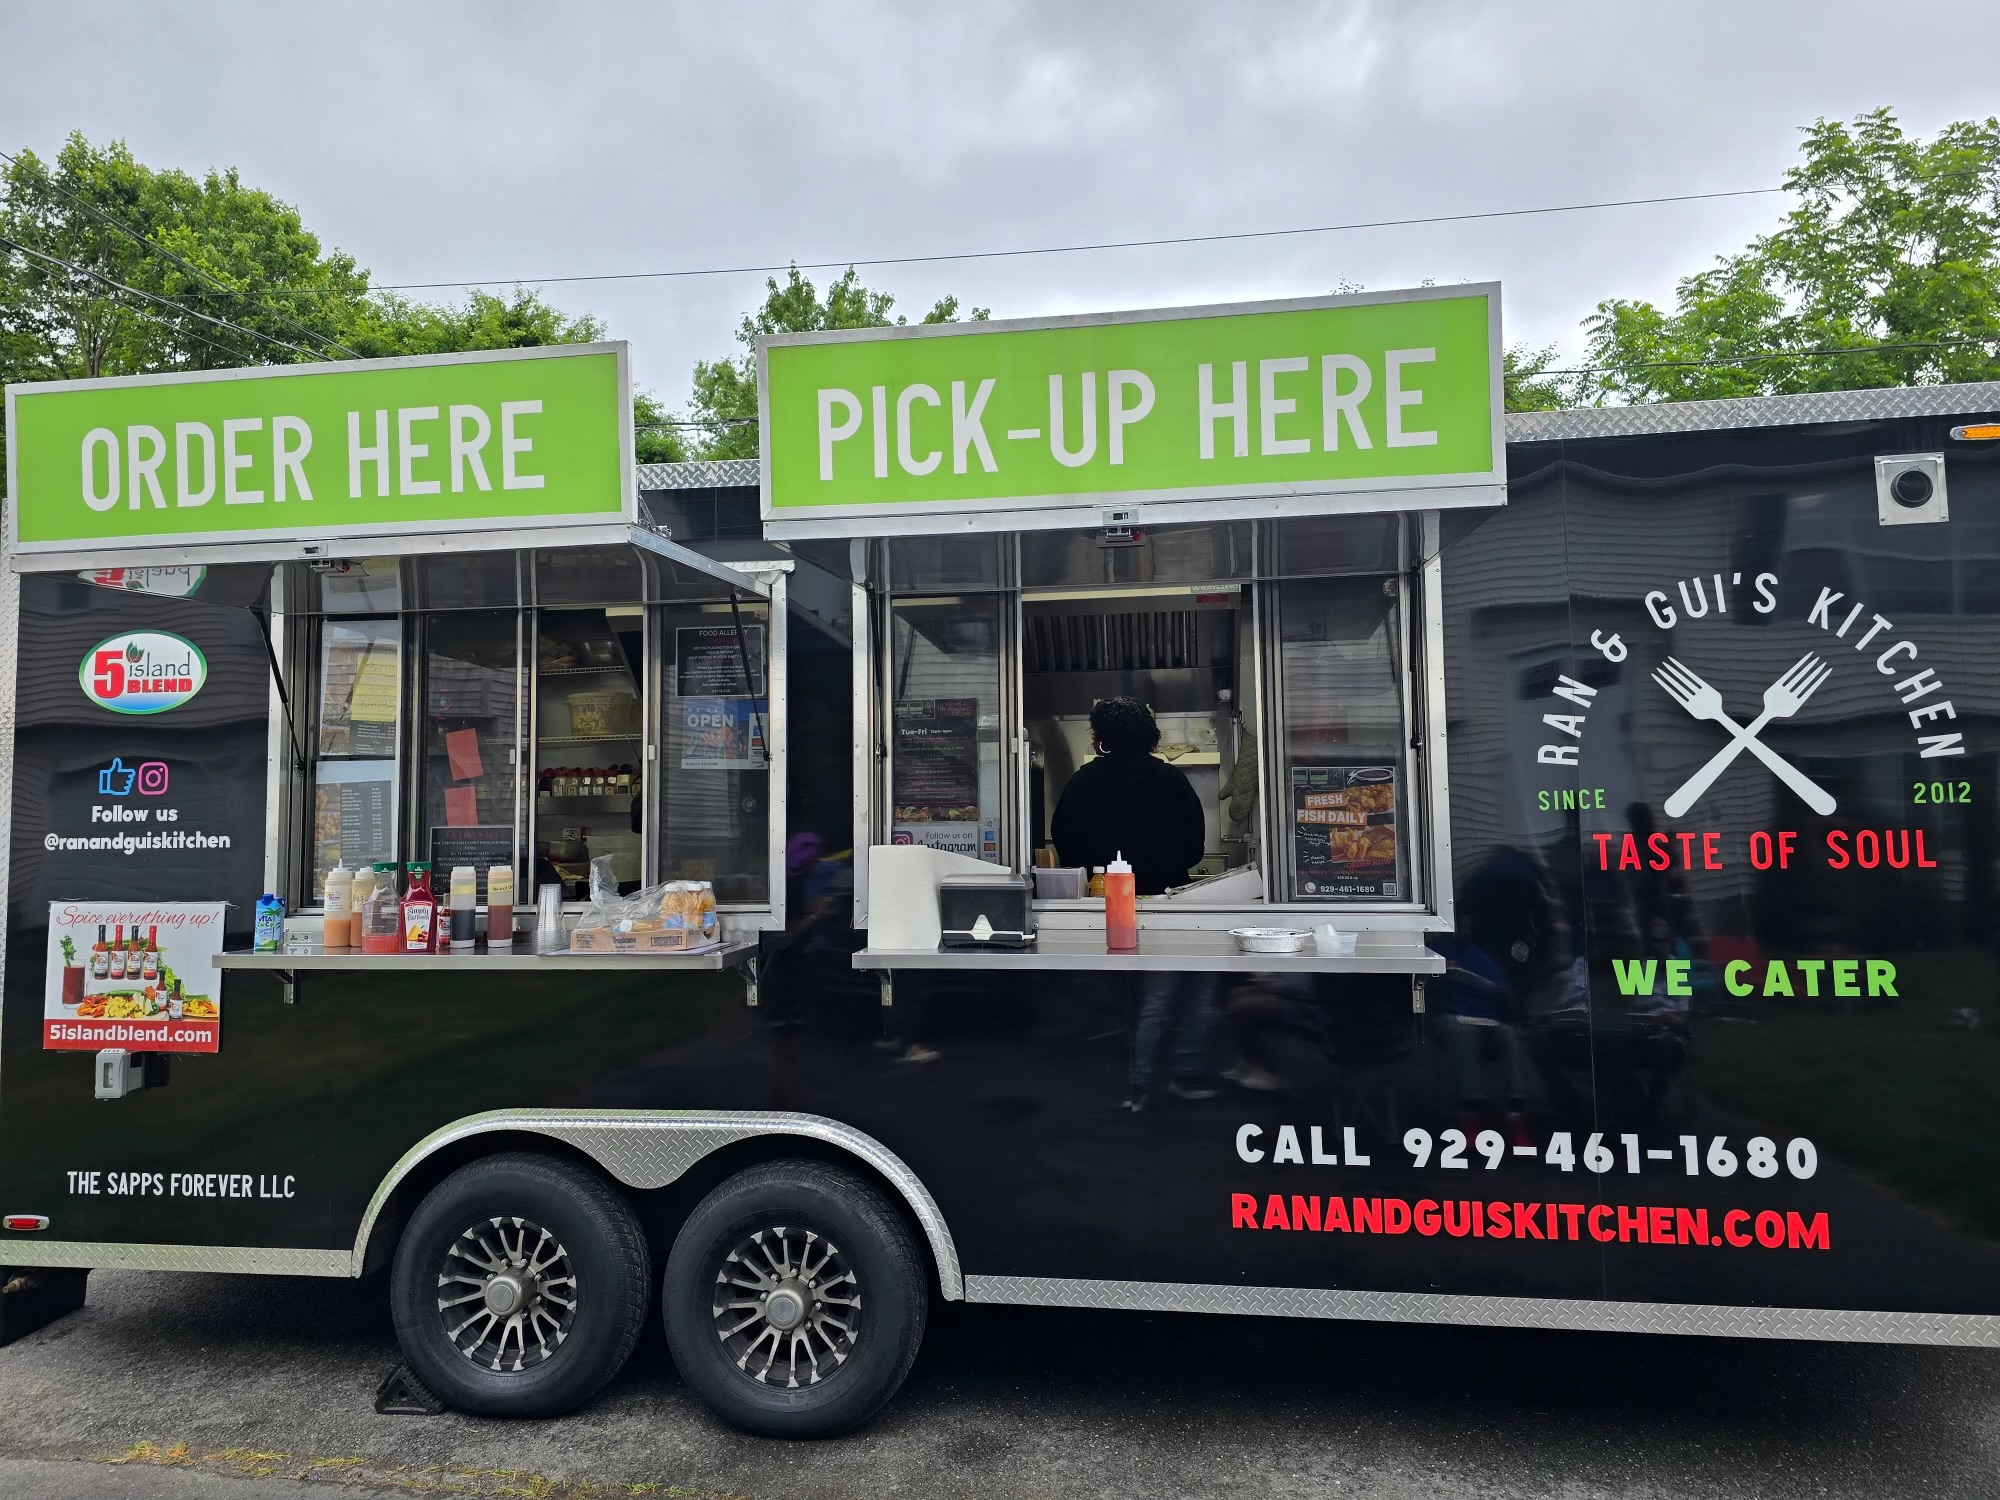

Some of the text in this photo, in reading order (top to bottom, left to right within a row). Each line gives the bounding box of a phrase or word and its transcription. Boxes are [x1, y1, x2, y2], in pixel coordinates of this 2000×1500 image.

[817, 347, 1438, 481] PICK-UP HERE
[82, 400, 544, 512] ORDER HERE
[94, 650, 191, 699] 5 island
[1537, 573, 1966, 766] RAN & GUI'S KITCHEN
[127, 678, 193, 693] BLEND
[687, 714, 734, 728] OPEN
[1307, 794, 1343, 806] FRESH
[1538, 782, 1972, 811] SINCE 2012
[92, 805, 179, 822] Follow us
[1297, 809, 1367, 824] FISH DAILY
[44, 830, 231, 855] @ranandguiskitchen
[1593, 829, 1937, 871] TASTE OF SOUL
[1320, 885, 1375, 893] 929-461-1680
[56, 906, 220, 929] Spice everything up!
[407, 907, 429, 915] Simply
[1612, 959, 1900, 997] WE CATER
[50, 1024, 212, 1043] 5islandblend.com
[1235, 1123, 1818, 1180] CALL 929-461-1680
[67, 1171, 295, 1198] THE SAPPS FOREVER LLC
[1231, 1193, 1831, 1250] RANANDGUISKITCHEN.COM
